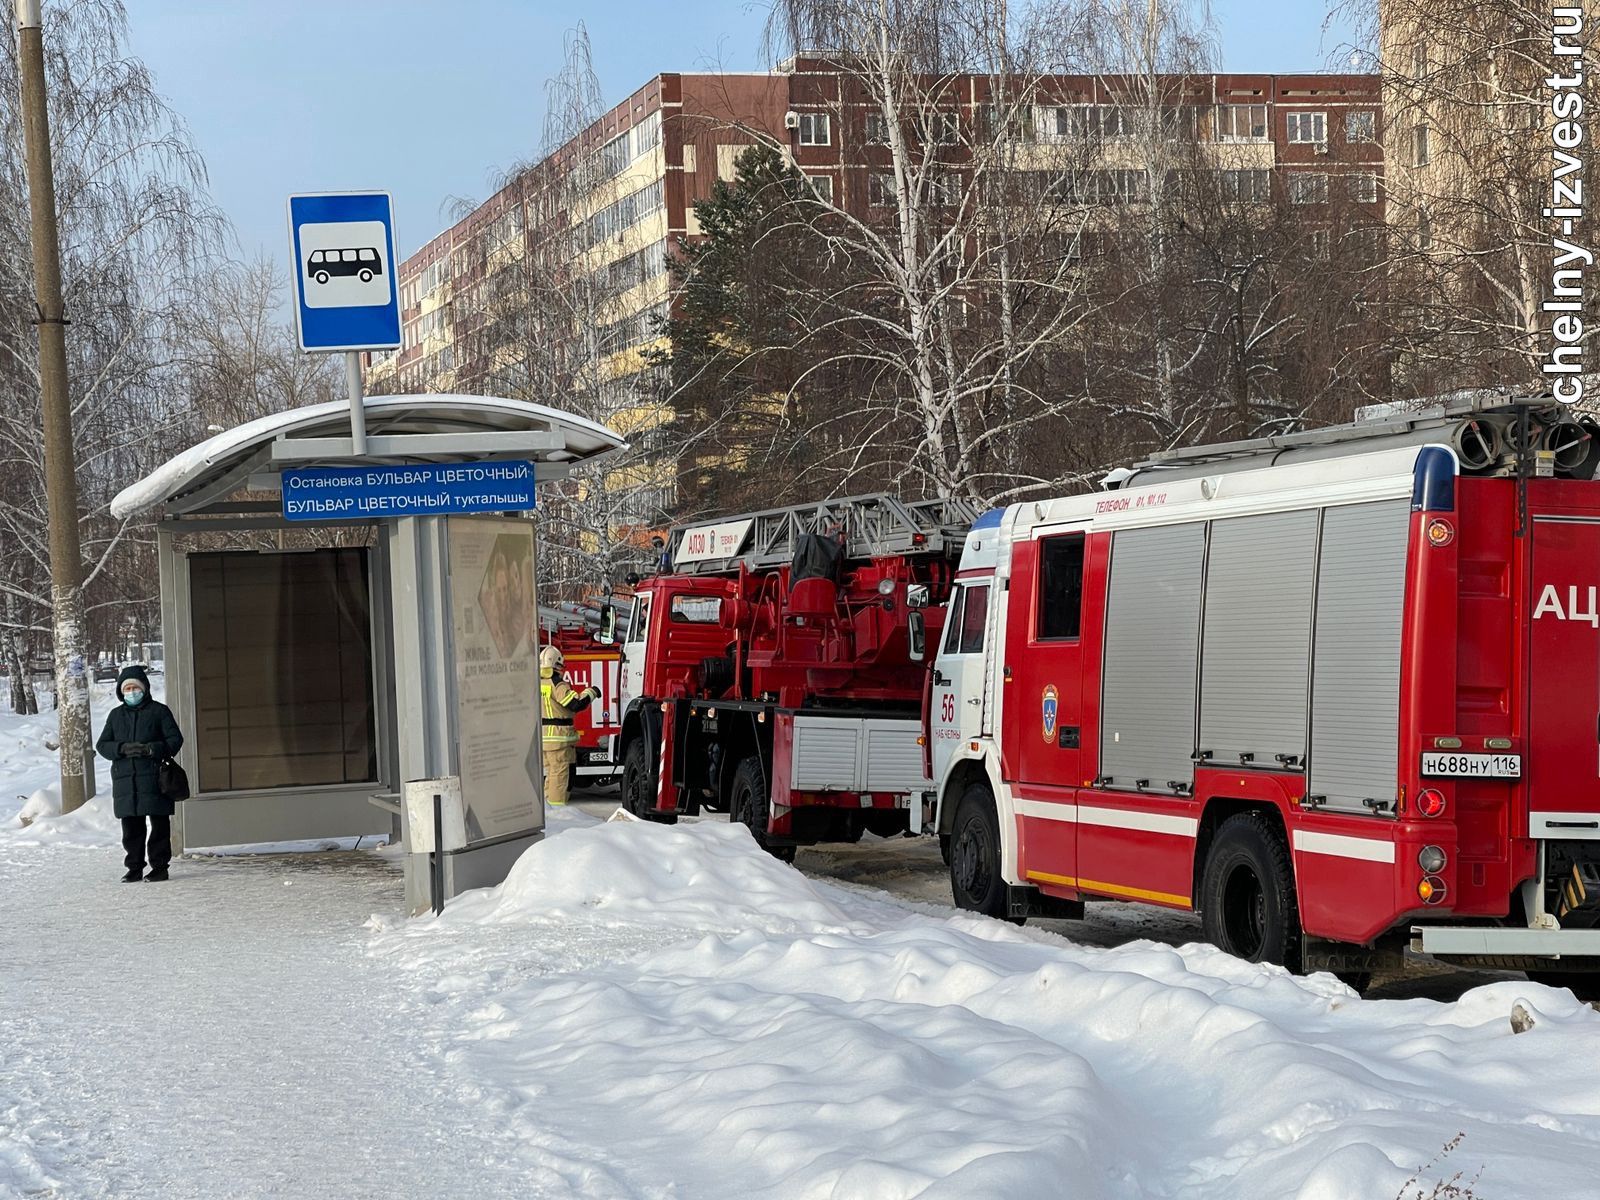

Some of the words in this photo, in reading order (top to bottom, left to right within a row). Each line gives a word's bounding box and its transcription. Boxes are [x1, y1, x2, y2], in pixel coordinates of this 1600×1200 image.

[290, 475, 362, 489] Остановка
[367, 471, 432, 487] БУЛЬВАР
[436, 465, 527, 485] ЦВЕТОЧНЫЙ
[287, 498, 354, 513] БУЛЬВАР
[358, 492, 450, 512] ЦВЕТОЧНЫЙ
[454, 493, 528, 507] тукталышы
[1095, 497, 1131, 513] ТЕЛЕФОН
[1532, 584, 1599, 628] АЦ
[562, 670, 588, 687] АЦ
[942, 693, 955, 722] 56
[1427, 756, 1489, 773] Н688НУ
[1493, 757, 1516, 770] 116
